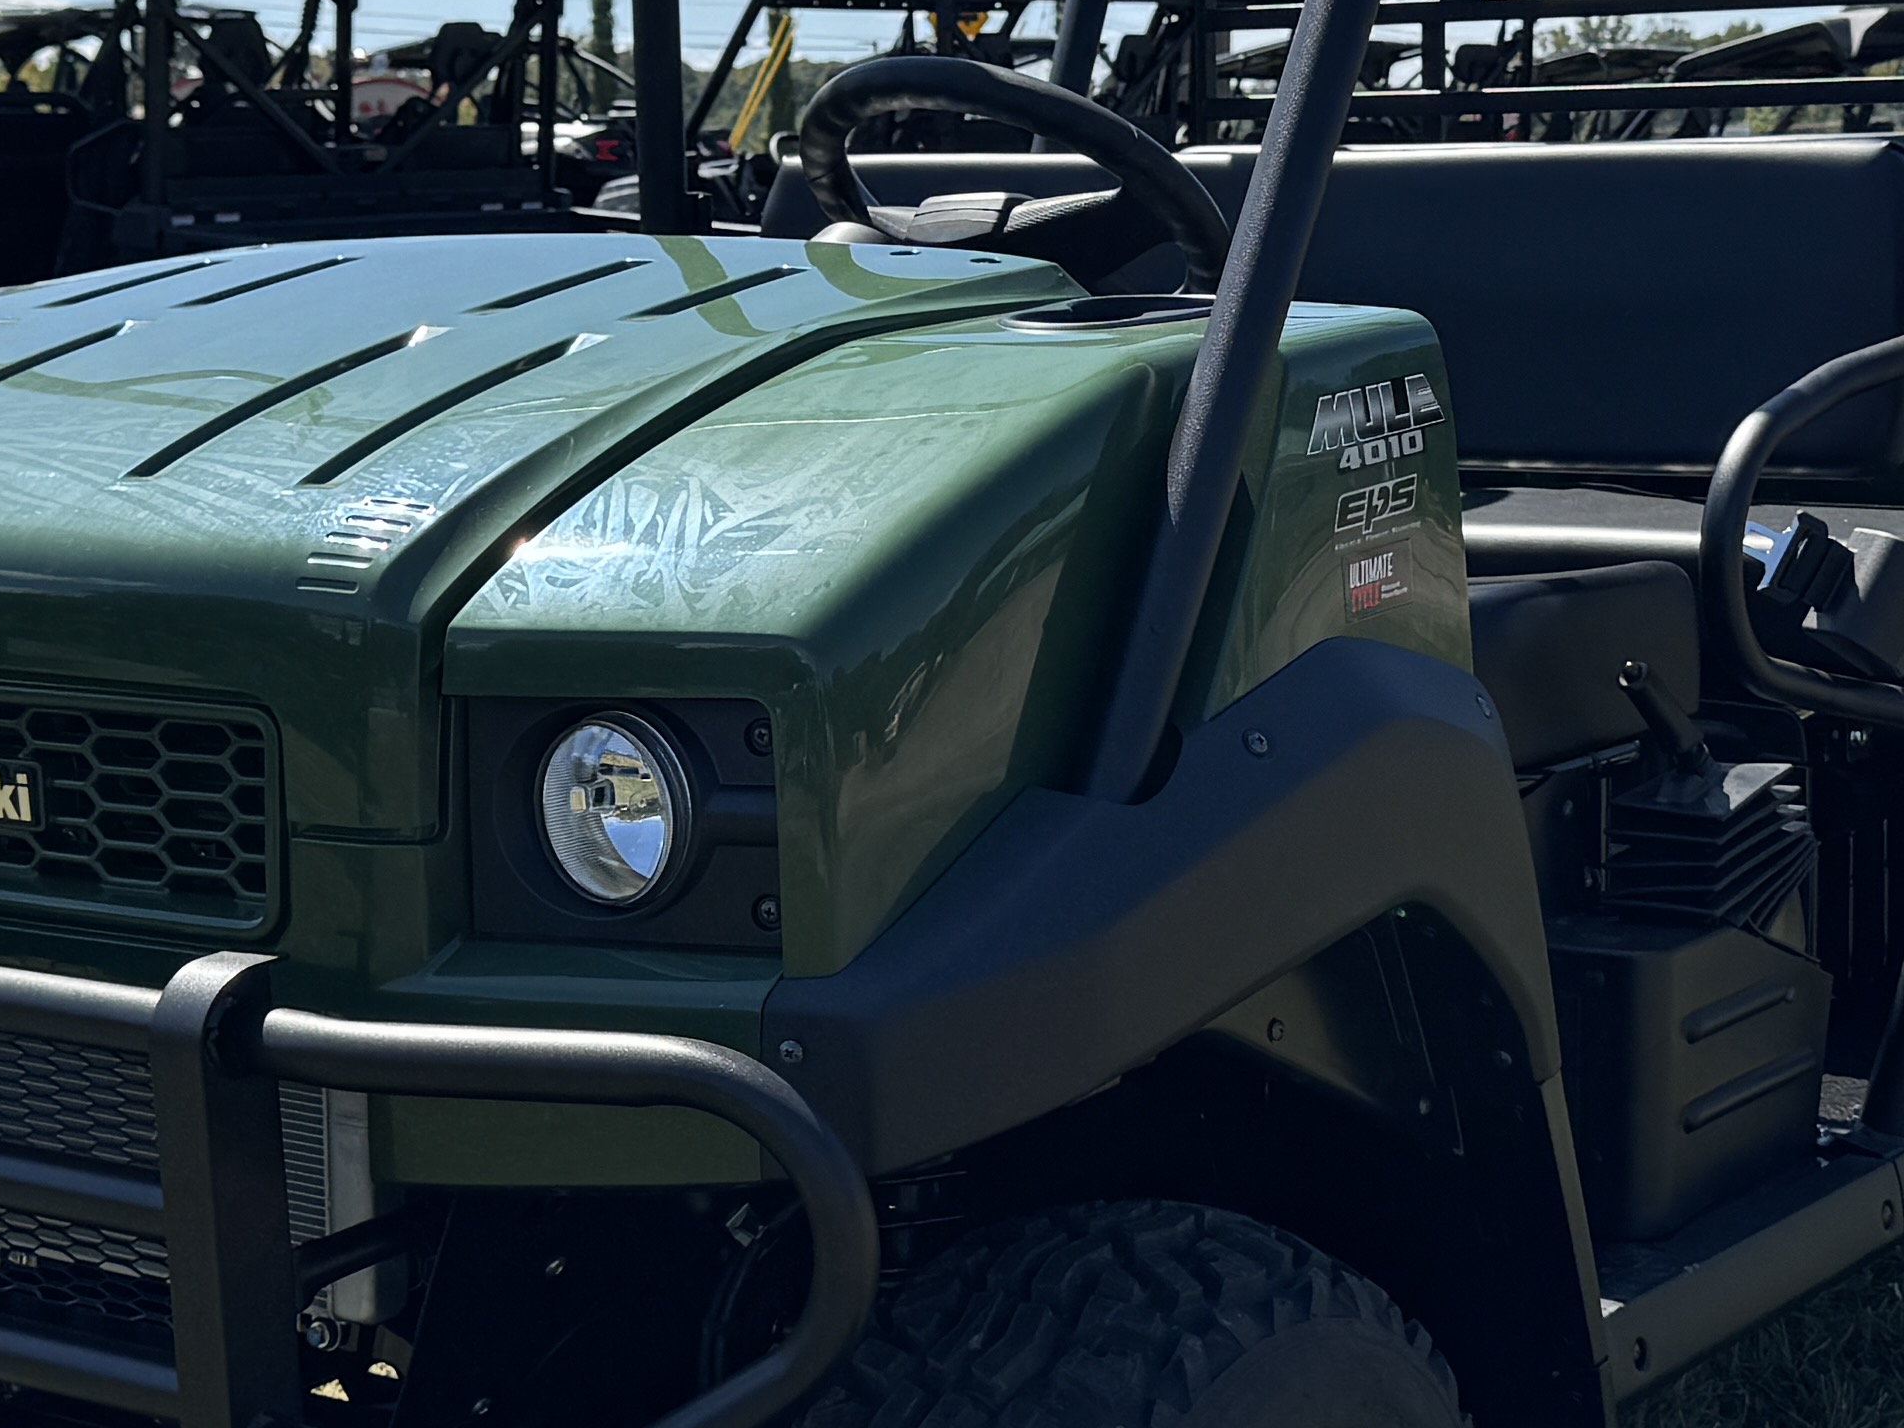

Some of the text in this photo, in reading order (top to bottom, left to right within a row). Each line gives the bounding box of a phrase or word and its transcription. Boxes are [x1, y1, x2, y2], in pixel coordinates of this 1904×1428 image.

[1307, 373, 1445, 456] MULE
[1339, 429, 1424, 470] 4010
[1349, 551, 1394, 589] ULTIMATE
